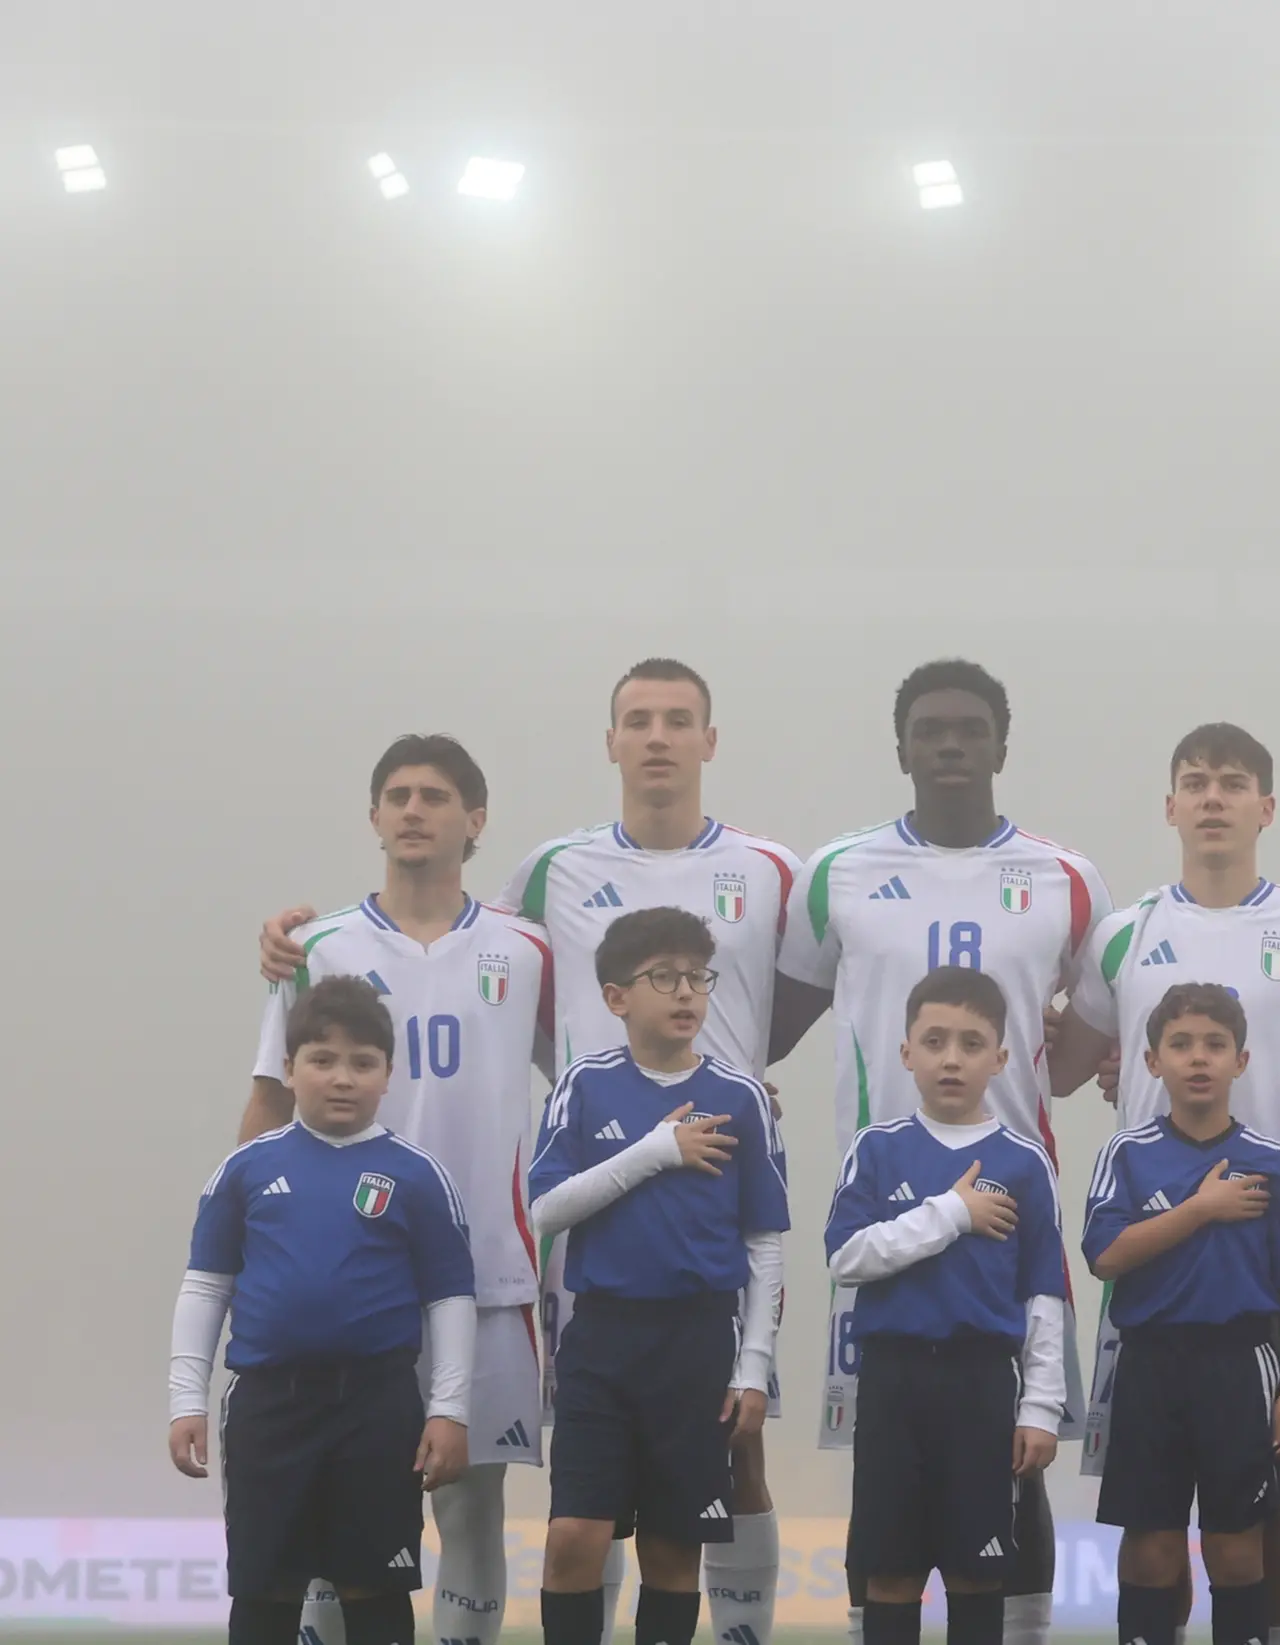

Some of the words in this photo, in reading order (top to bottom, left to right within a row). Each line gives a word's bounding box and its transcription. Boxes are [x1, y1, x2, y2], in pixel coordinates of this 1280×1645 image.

[716, 882, 743, 893] ITALIA
[1002, 876, 1029, 887] ITALIA
[928, 920, 982, 968] 18
[480, 963, 506, 973] ITALIA
[407, 1014, 461, 1080] 10
[362, 1176, 391, 1190] ITALIA
[829, 1312, 860, 1376] 18
[442, 1588, 498, 1613] ITALIA
[708, 1587, 760, 1603] ITALIA
